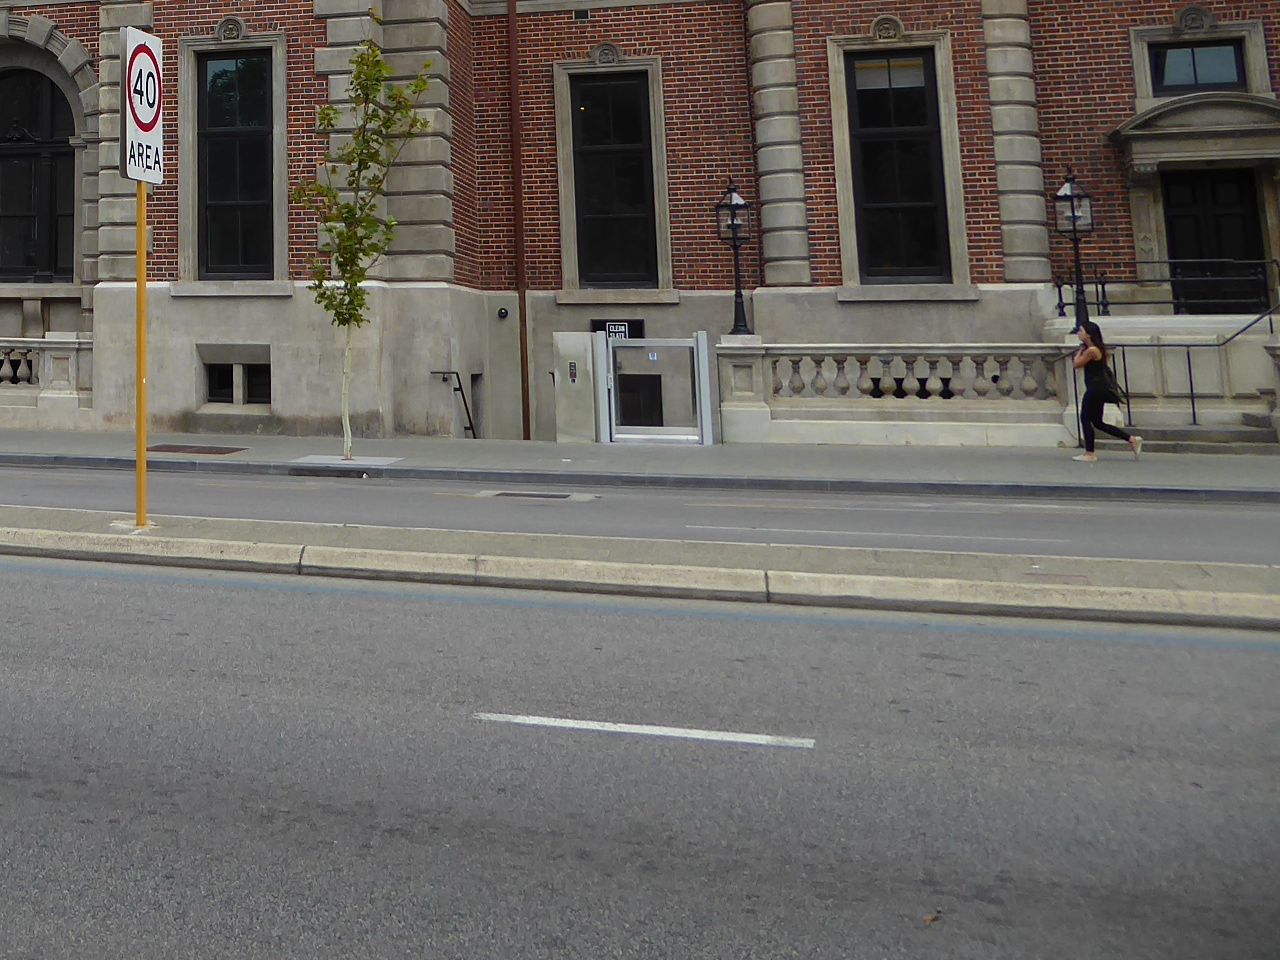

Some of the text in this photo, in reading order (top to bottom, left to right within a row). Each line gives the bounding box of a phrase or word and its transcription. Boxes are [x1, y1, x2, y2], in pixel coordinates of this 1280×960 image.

[133, 68, 157, 109] 40
[128, 140, 162, 173] AREA
[609, 324, 625, 332] CLEAN
